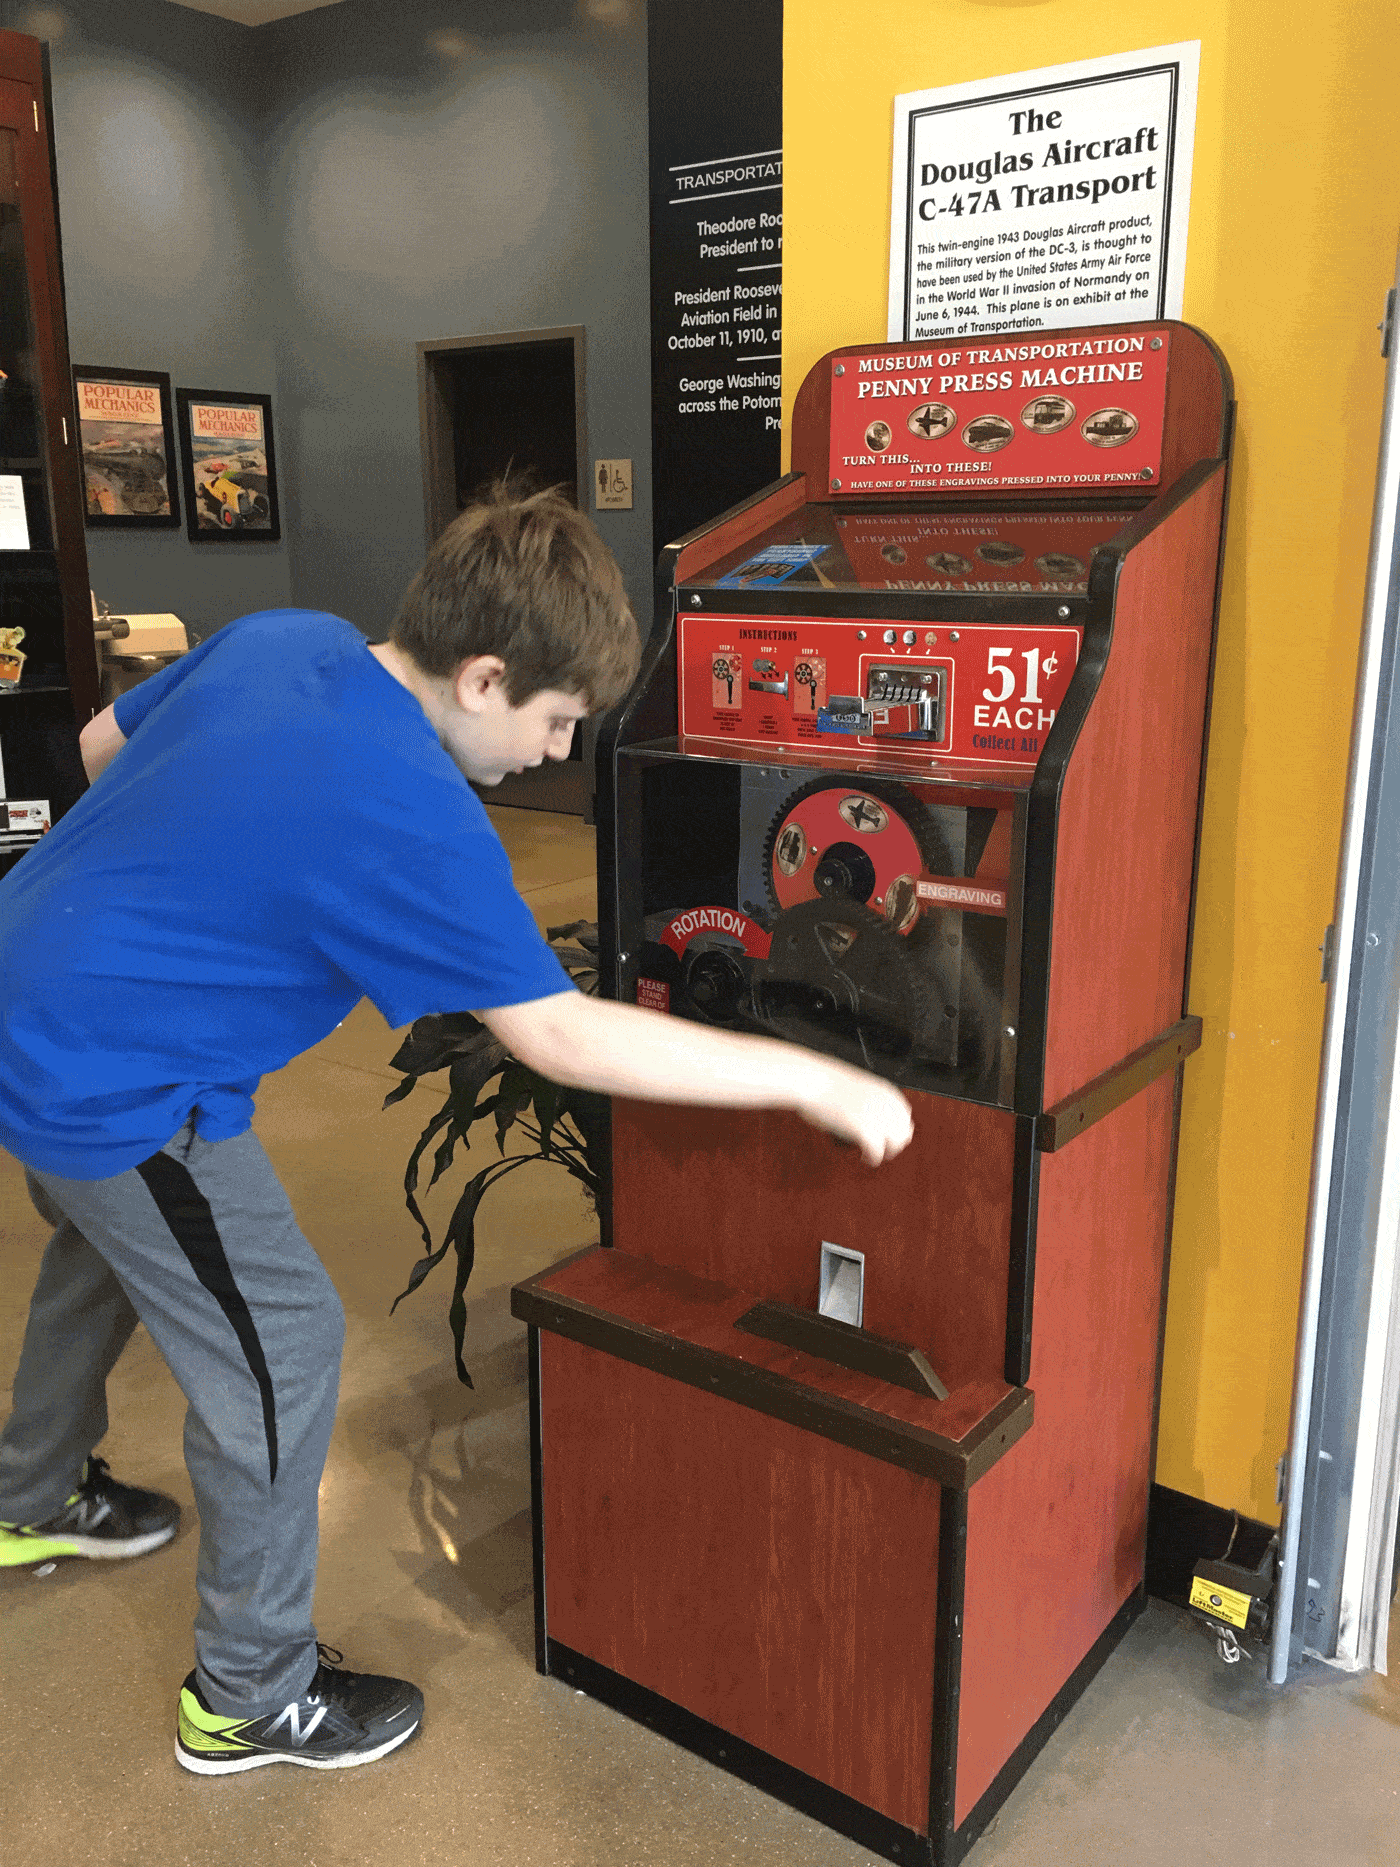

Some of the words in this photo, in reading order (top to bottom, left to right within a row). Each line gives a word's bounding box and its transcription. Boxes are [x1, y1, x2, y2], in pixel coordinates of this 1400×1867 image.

[1008, 108, 1062, 135] The
[921, 151, 1033, 186] Douglas
[1042, 127, 1159, 167] Aircraft
[919, 189, 1002, 221] C-47A
[1011, 165, 1157, 208] Transport
[697, 216, 756, 236] Theodore
[917, 243, 935, 254] This
[938, 236, 994, 252] twin-engine
[998, 232, 1019, 244] 1943
[1023, 227, 1063, 241] Douglas
[1067, 220, 1105, 235] Aircraft
[1109, 214, 1152, 232] product,
[700, 238, 758, 258] President
[761, 237, 774, 251] to
[917, 261, 932, 271] the
[936, 256, 973, 269] military
[976, 251, 1011, 264] version
[1015, 248, 1025, 259] of
[1029, 247, 1045, 258] the
[1049, 242, 1077, 255] DC-3,
[1082, 240, 1090, 251] is
[1094, 234, 1137, 250] thought
[1141, 234, 1151, 244] to
[917, 278, 937, 288] have
[940, 275, 960, 286] been
[963, 270, 983, 283] used
[986, 269, 996, 282] by
[999, 267, 1013, 278] the
[1017, 263, 1046, 277] United
[1050, 261, 1077, 273] States
[1081, 258, 1105, 270] Army
[1108, 254, 1121, 266] Air
[1125, 253, 1151, 264] Force
[675, 287, 730, 305] President
[917, 294, 925, 304] in
[928, 293, 944, 303] the
[947, 288, 975, 301] World
[979, 287, 999, 298] War
[1003, 285, 1009, 295] II
[1013, 280, 1055, 294] invasion
[1060, 277, 1070, 289] of
[1074, 271, 1131, 287] Normandy
[1135, 271, 1149, 281] on
[915, 311, 938, 321] June
[942, 308, 950, 320] 6,
[954, 306, 980, 317] 1944.
[987, 302, 1006, 314] This
[1010, 300, 1040, 314] plane
[1044, 297, 1051, 308] is
[1055, 298, 1069, 307] on
[1073, 291, 1111, 305] exhibit
[1114, 290, 1126, 300] at
[1130, 288, 1149, 299] the
[681, 310, 730, 327] Aviation
[733, 304, 762, 322] Field
[766, 304, 777, 319] in
[915, 326, 954, 338] Museum
[958, 323, 967, 333] of
[971, 316, 1044, 332] Transportation.
[668, 333, 716, 350] October
[719, 331, 733, 347] 11,
[737, 328, 767, 344] 1910,
[858, 355, 933, 373] MUSEUM
[938, 352, 962, 367] OF
[967, 337, 1145, 364] TRANSPORTATION
[680, 378, 723, 394] George
[857, 377, 933, 399] PENNY
[939, 371, 1013, 394] PRESS
[1020, 362, 1143, 388] MACHINE
[83, 385, 154, 401] POPULAR
[84, 398, 155, 414] MECHANICS
[679, 400, 716, 413] across
[719, 396, 739, 411] the
[198, 409, 256, 422] POPULAR
[199, 419, 257, 433] MECHANICS
[843, 455, 876, 466] TURN
[880, 454, 920, 464] THIS...
[910, 464, 942, 474] INTO
[946, 462, 992, 473] THESE!
[851, 481, 873, 489] HAVE
[896, 480, 907, 488] OF
[940, 477, 999, 486] ENGRAVINGS
[1001, 476, 1043, 484] PRESSED
[1074, 474, 1100, 482] YOUR
[739, 629, 798, 641] INSTRUCTIONS
[983, 647, 1058, 703] 51¢
[974, 705, 1055, 730] EACH
[972, 734, 1015, 751] Collect
[1021, 738, 1038, 752] All
[919, 883, 1001, 905] ENGRAVING
[671, 909, 746, 940] ROTATION
[638, 978, 666, 993] PLEASE
[642, 990, 662, 1000] STAND
[639, 997, 656, 1007] CLEAR
